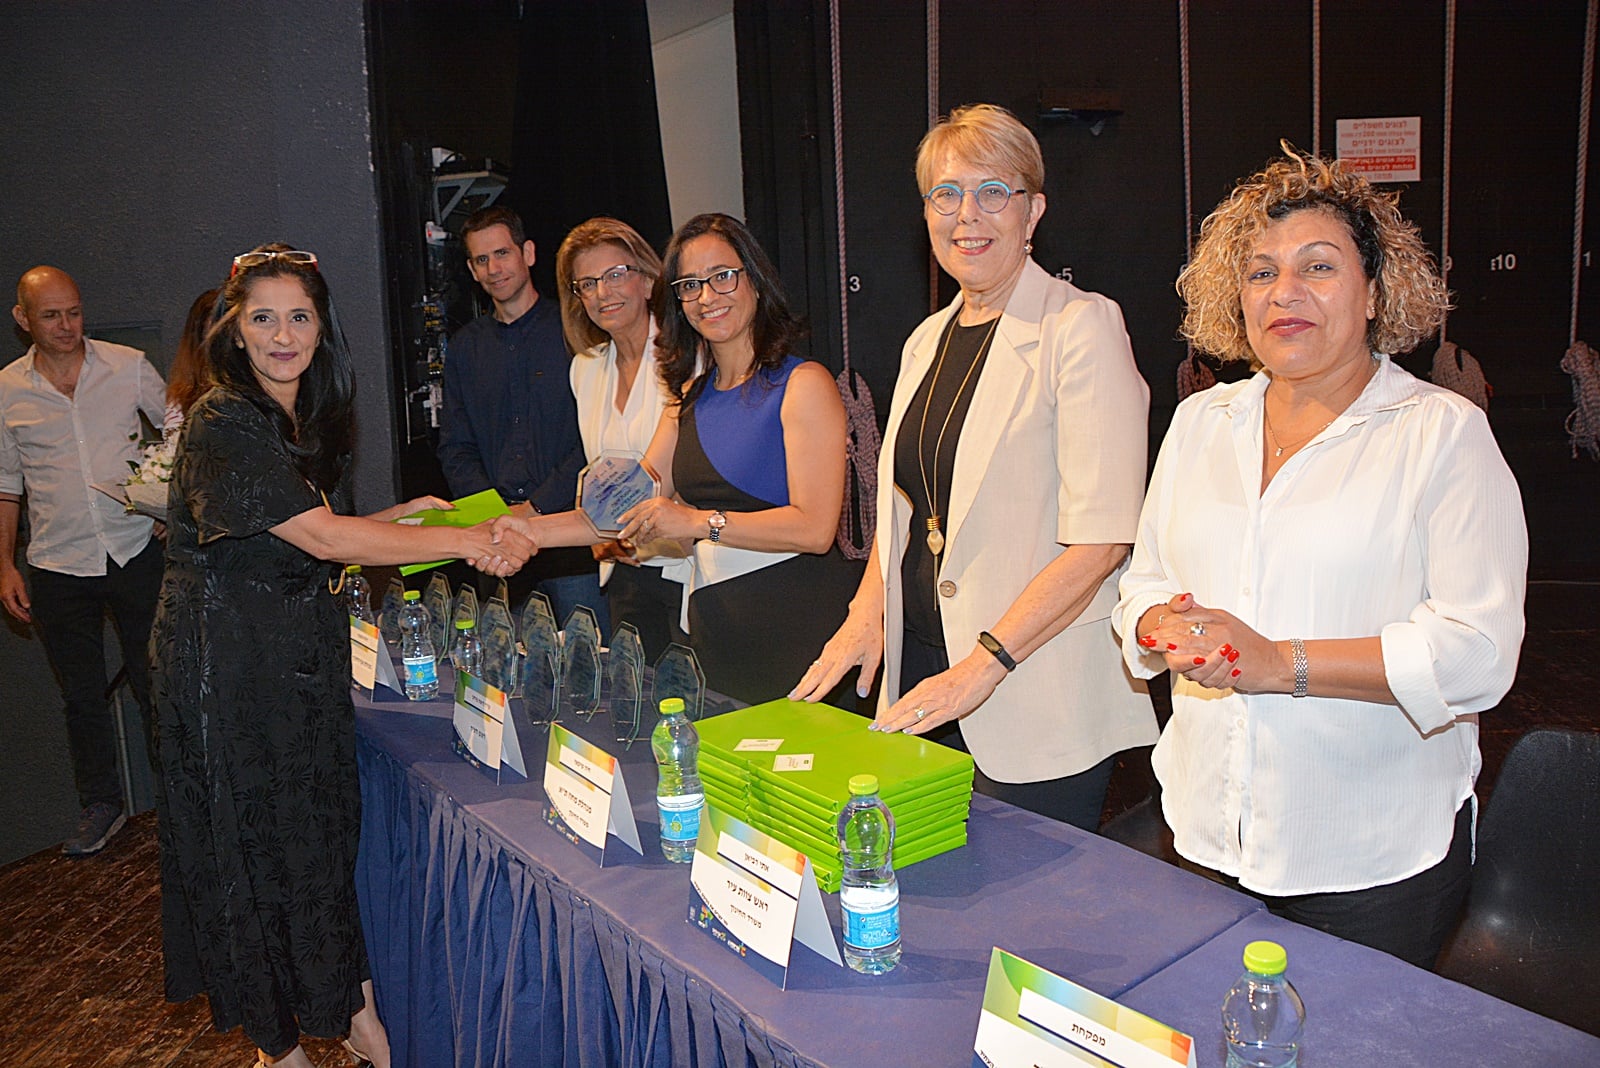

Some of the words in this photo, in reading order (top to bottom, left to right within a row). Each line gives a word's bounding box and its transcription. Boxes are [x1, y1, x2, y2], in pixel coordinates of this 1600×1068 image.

[849, 275, 861, 292] 3
[727, 880, 737, 892] עיר
[738, 887, 753, 901] צוות
[753, 895, 769, 912] ראש
[730, 904, 746, 919] החינוך
[747, 914, 762, 929] משרד
[1071, 1023, 1107, 1047] מפקחת
